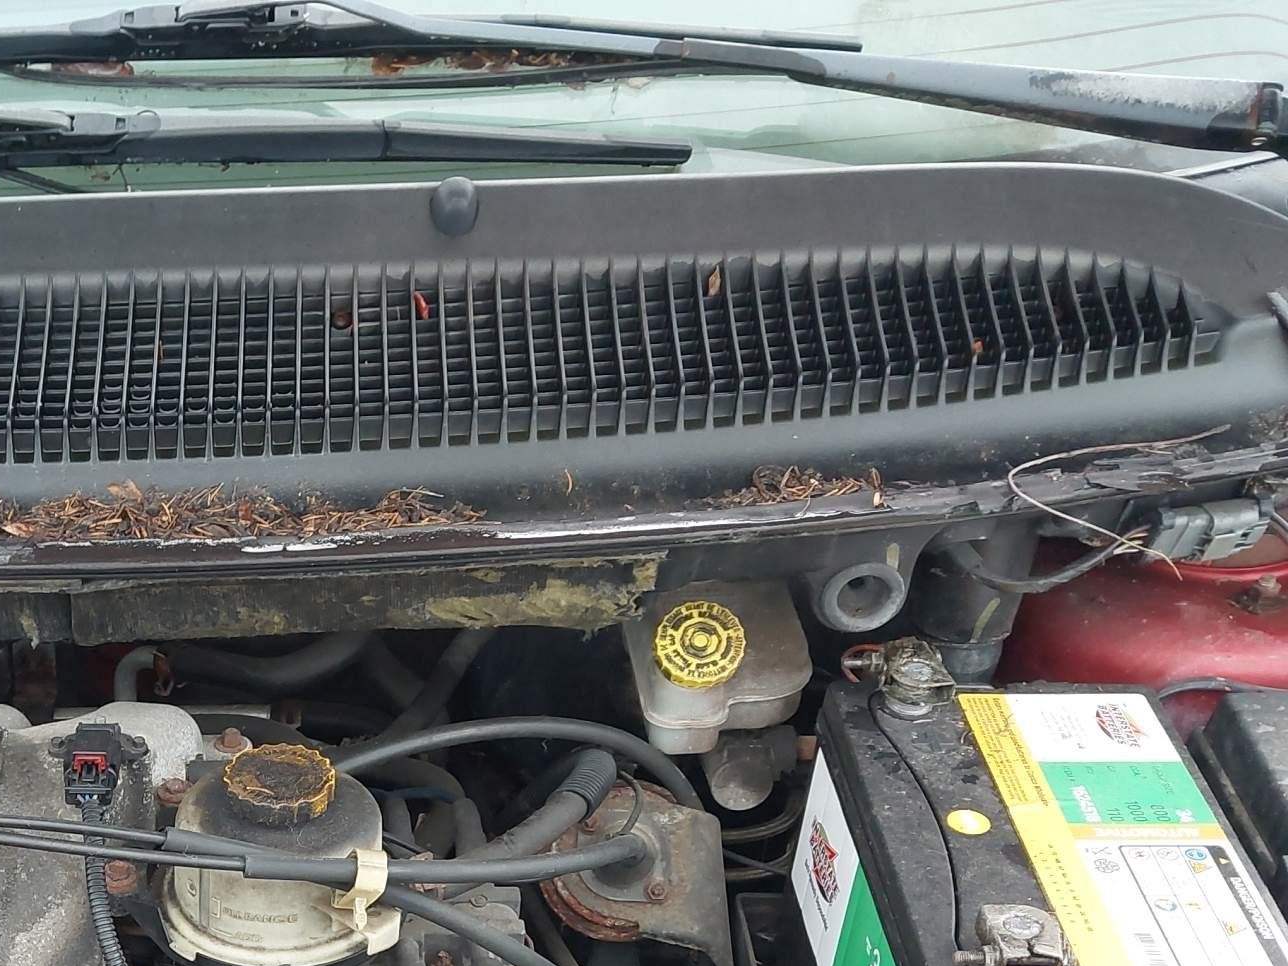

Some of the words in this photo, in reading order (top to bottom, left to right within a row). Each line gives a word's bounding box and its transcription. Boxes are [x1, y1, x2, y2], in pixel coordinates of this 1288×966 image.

[1096, 704, 1127, 745] BATTERIES
[1109, 704, 1141, 748] INTERSTATE
[1125, 801, 1148, 823] 1000
[1230, 876, 1275, 940] DANGER/POISON
